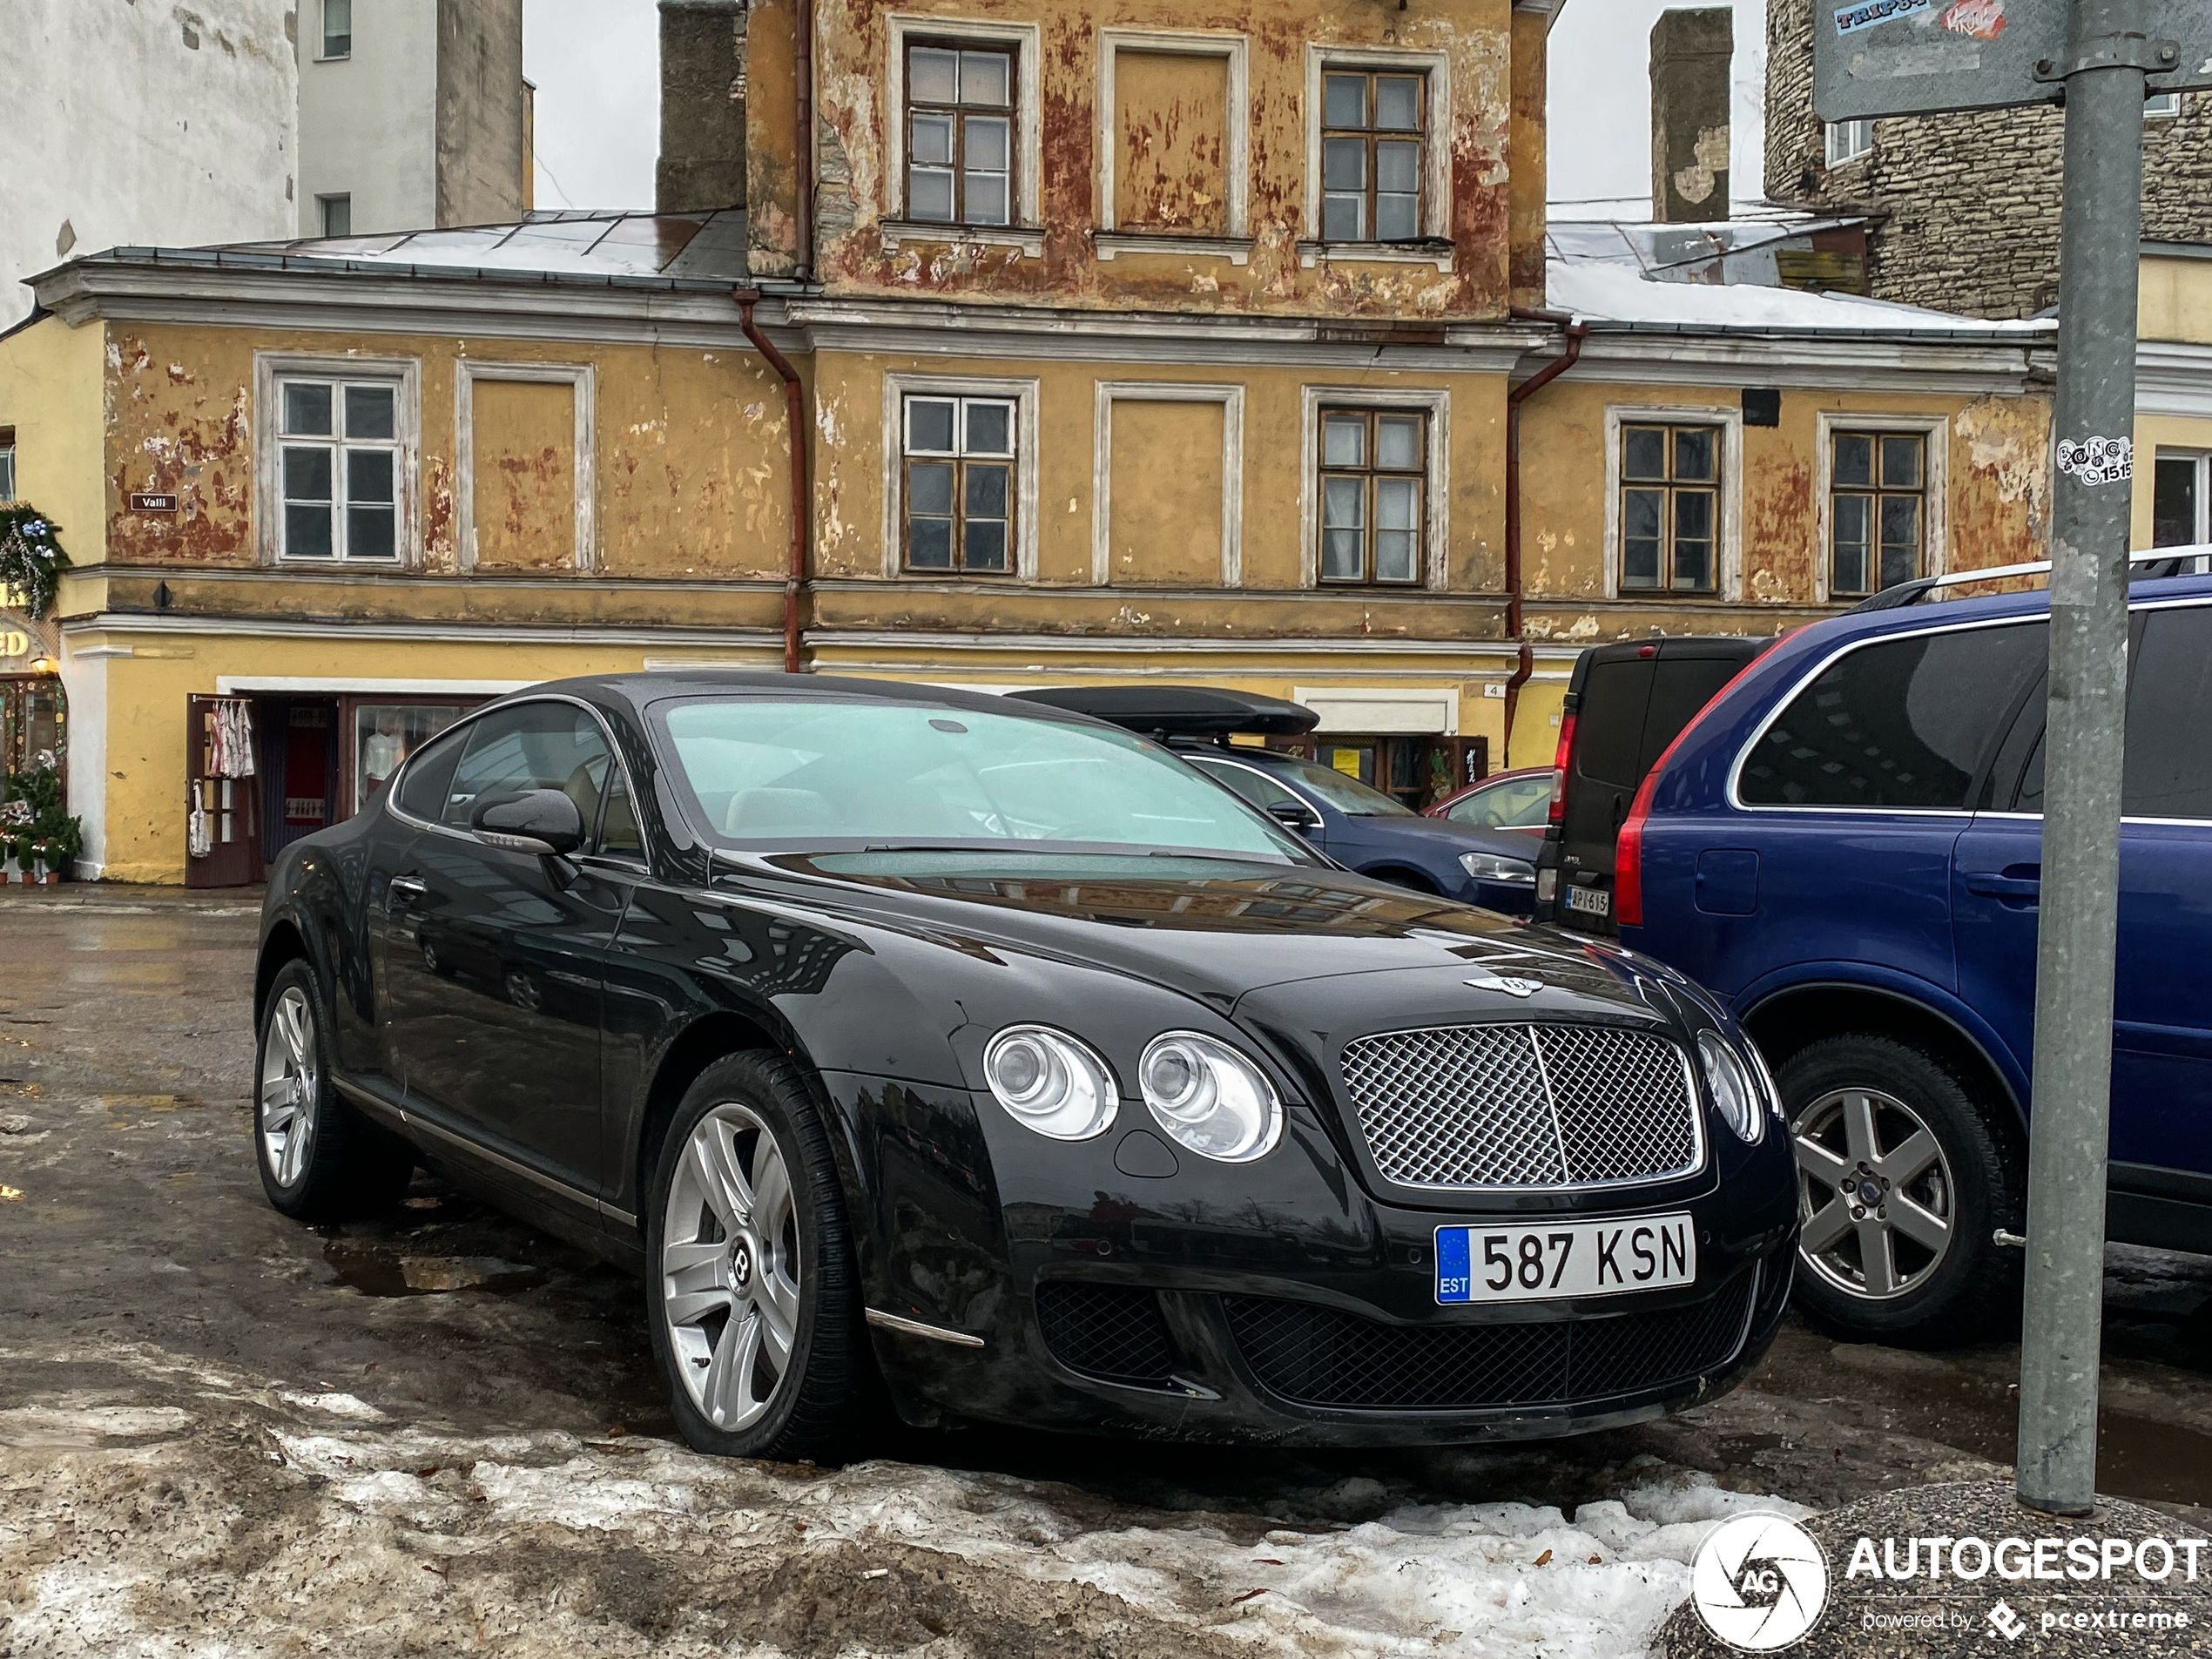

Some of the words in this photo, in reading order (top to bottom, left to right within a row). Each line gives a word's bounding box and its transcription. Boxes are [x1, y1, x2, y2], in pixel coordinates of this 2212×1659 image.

[142, 497, 166, 508] Valli
[1490, 685, 1497, 696] 4
[1440, 1278, 1468, 1294] EST
[1483, 1233, 1575, 1291] 587
[1596, 1223, 1686, 1286] KSN
